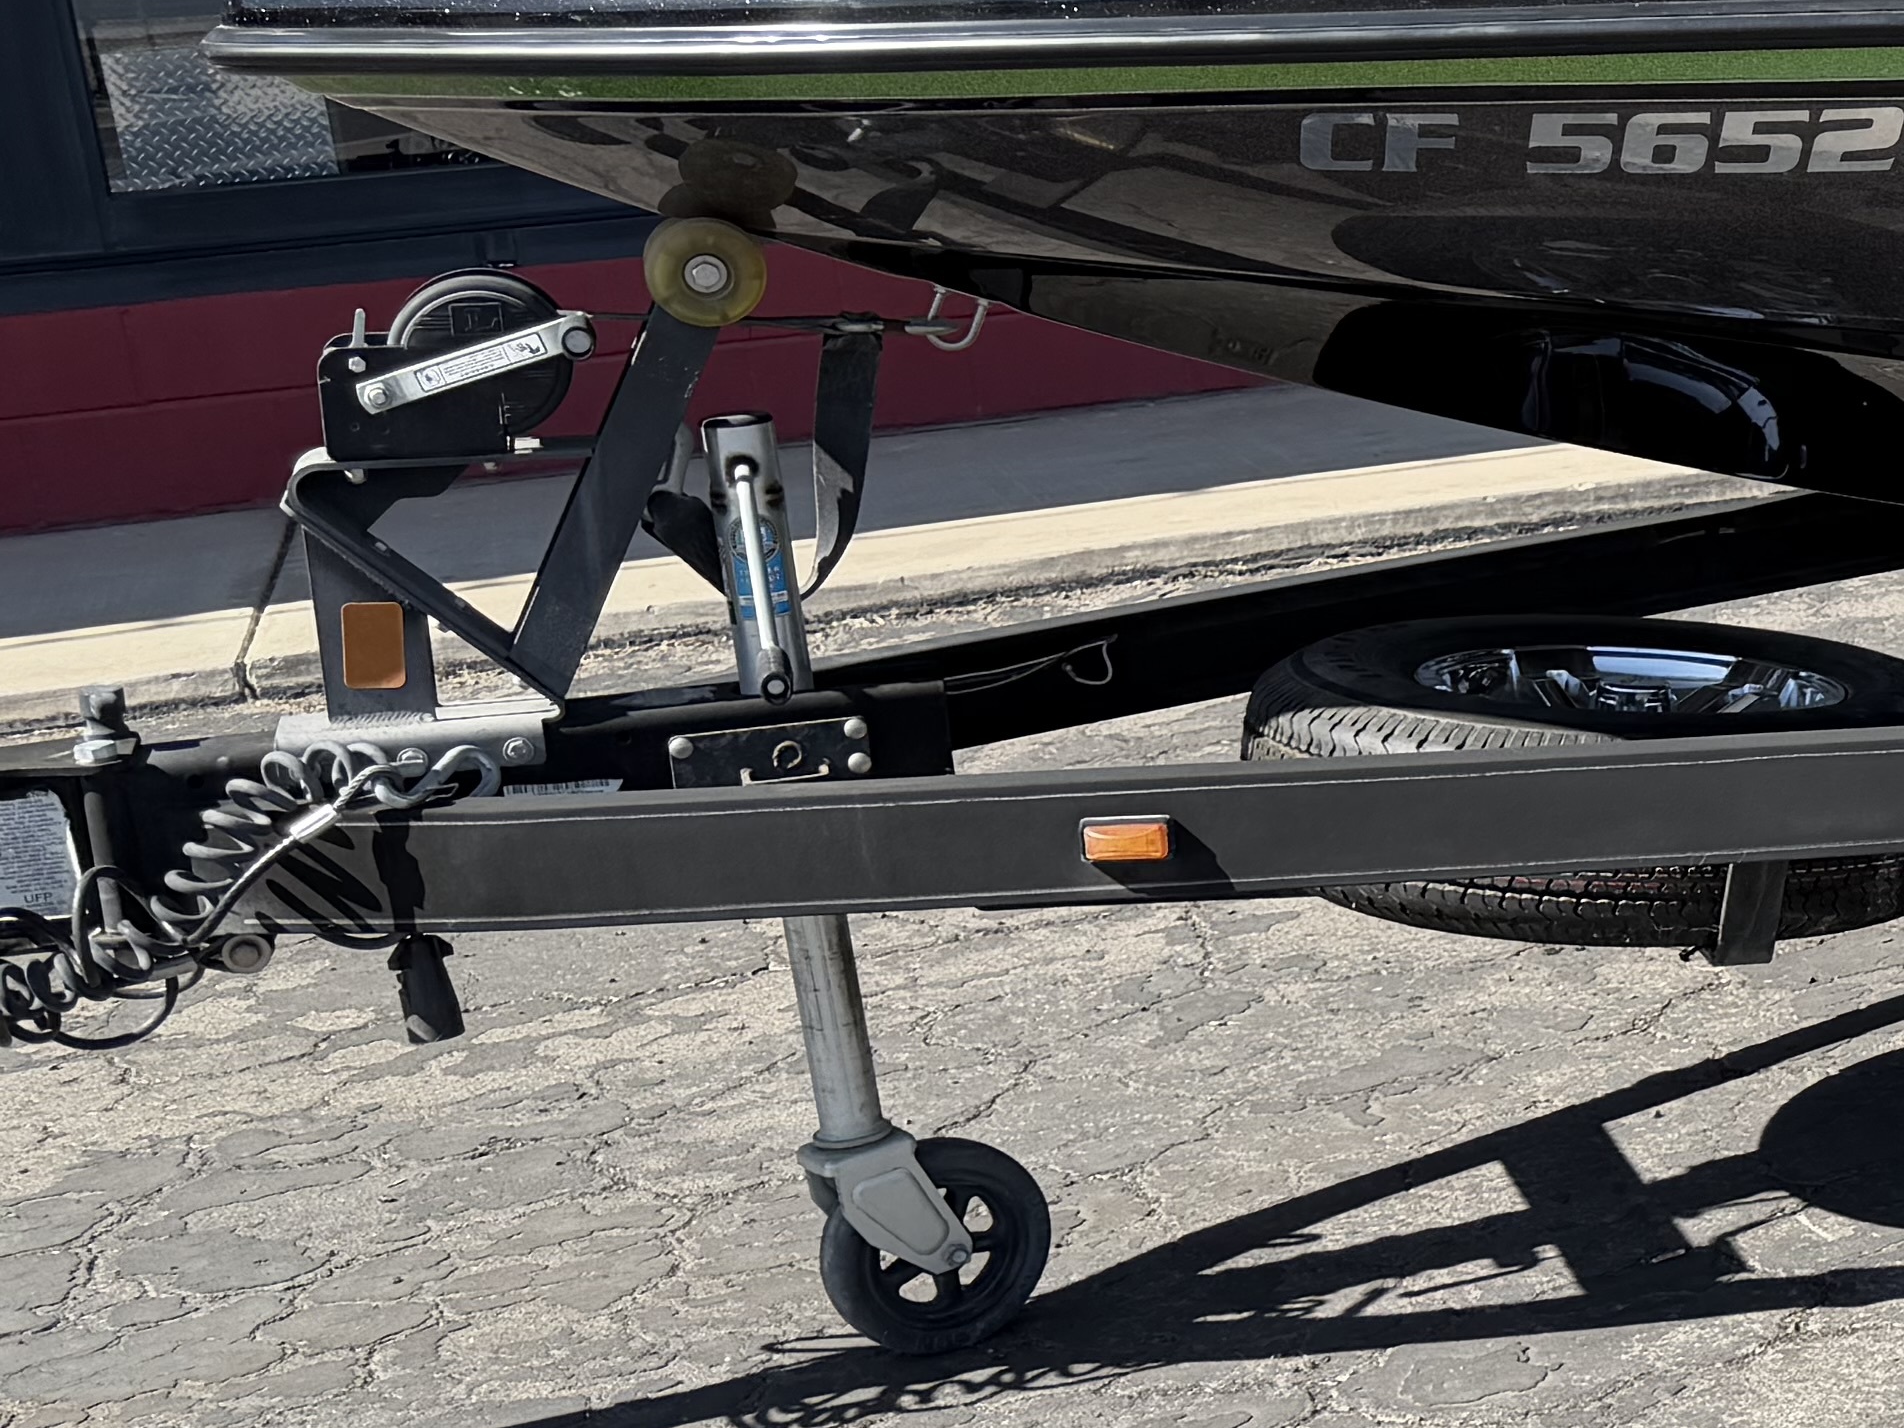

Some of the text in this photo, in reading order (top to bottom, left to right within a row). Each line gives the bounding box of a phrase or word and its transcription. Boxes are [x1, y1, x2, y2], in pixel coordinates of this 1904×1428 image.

[1299, 112, 1460, 172] CF
[1526, 107, 1904, 174] 5652
[23, 891, 54, 905] UFP
